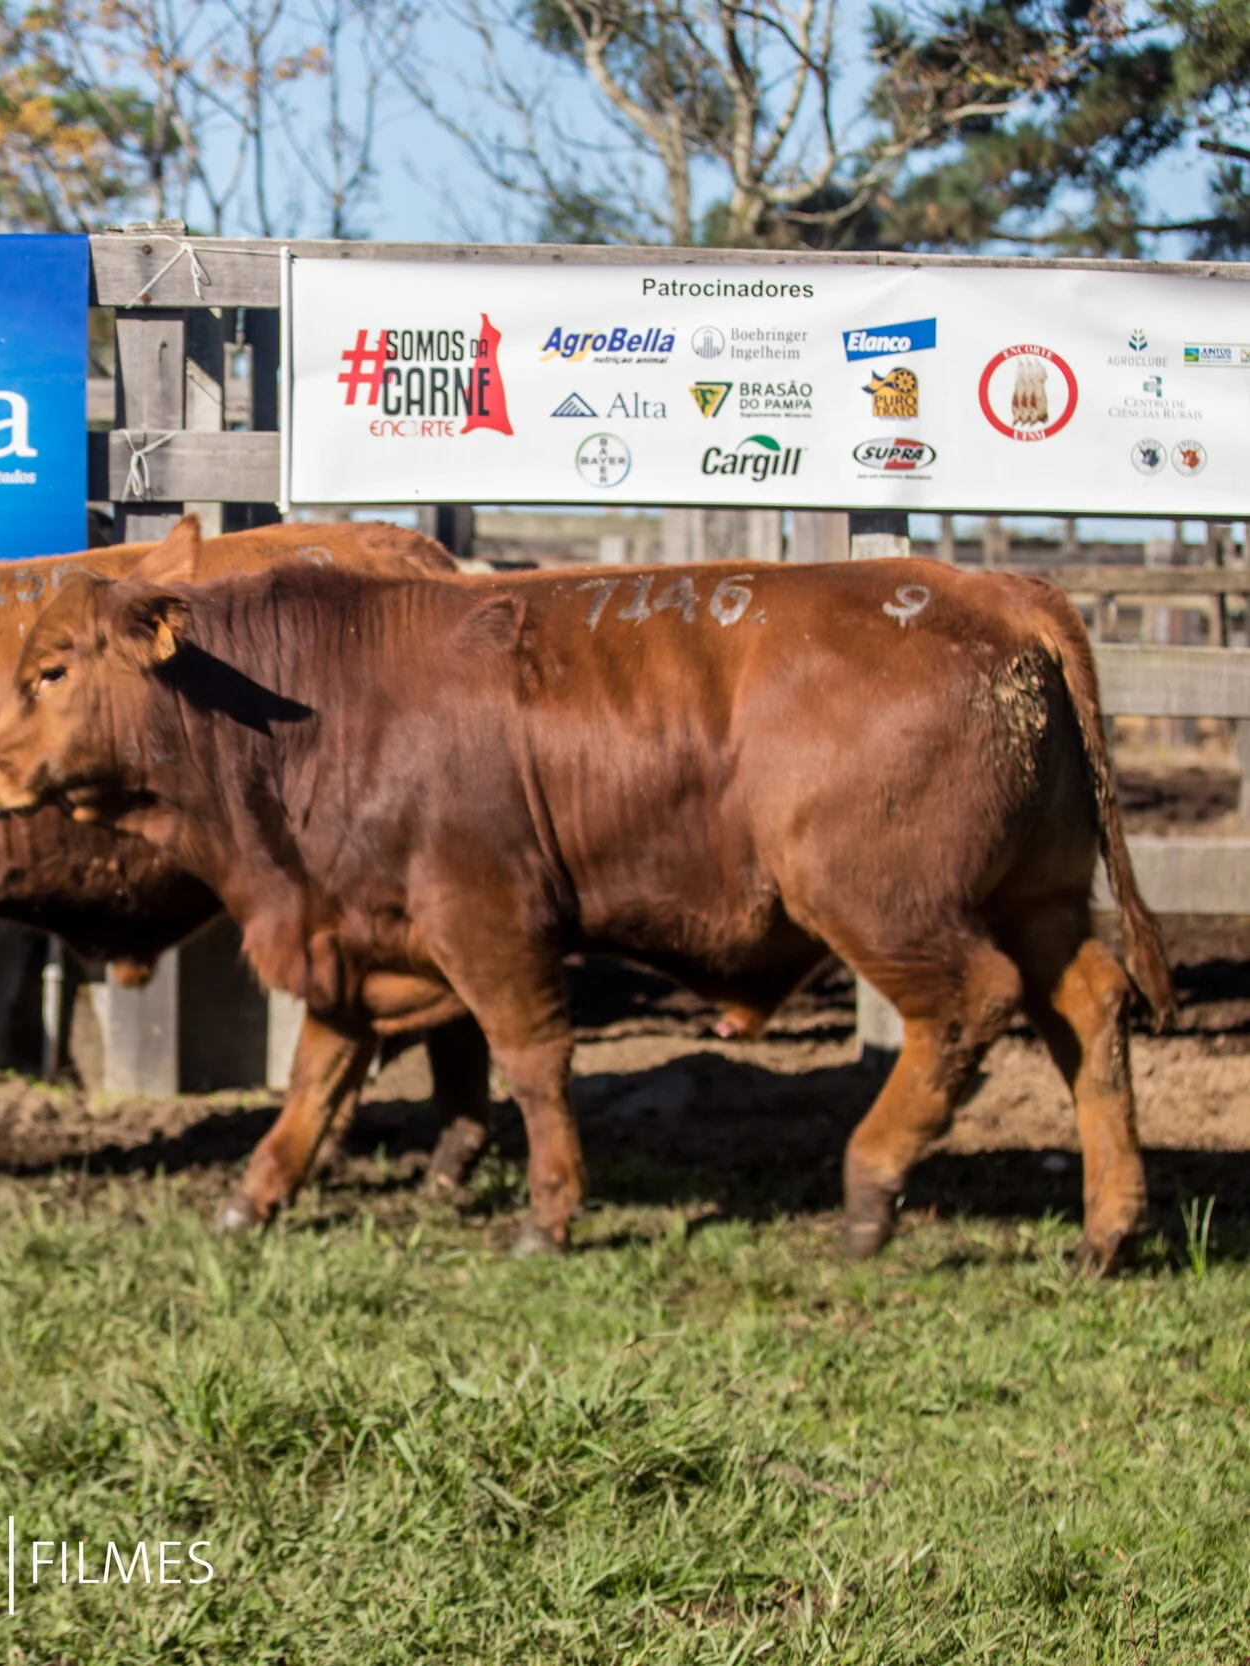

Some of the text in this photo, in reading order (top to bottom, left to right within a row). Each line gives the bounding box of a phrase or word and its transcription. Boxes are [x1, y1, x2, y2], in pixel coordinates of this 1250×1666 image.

[642, 278, 814, 298] Patrocinadores
[543, 326, 675, 359] AgroBella
[731, 327, 807, 344] Boehringer
[847, 331, 912, 353] Elanco
[470, 340, 488, 358] DA
[731, 345, 800, 361] Ingelheim
[636, 355, 668, 365] animal
[1107, 355, 1169, 368] AGROCLUBE
[383, 368, 490, 418] CARNE
[740, 379, 813, 397] BRASÃO
[606, 391, 668, 419] Alta
[740, 399, 813, 410] DO PAMPA
[874, 395, 917, 407] PURO
[875, 406, 917, 417] TRATO
[1164, 408, 1203, 420] RURAIS
[370, 420, 454, 438] ENCRTE
[580, 456, 626, 466] BAYER
[861, 446, 924, 461] SUPRA
[701, 446, 803, 482] Cargill
